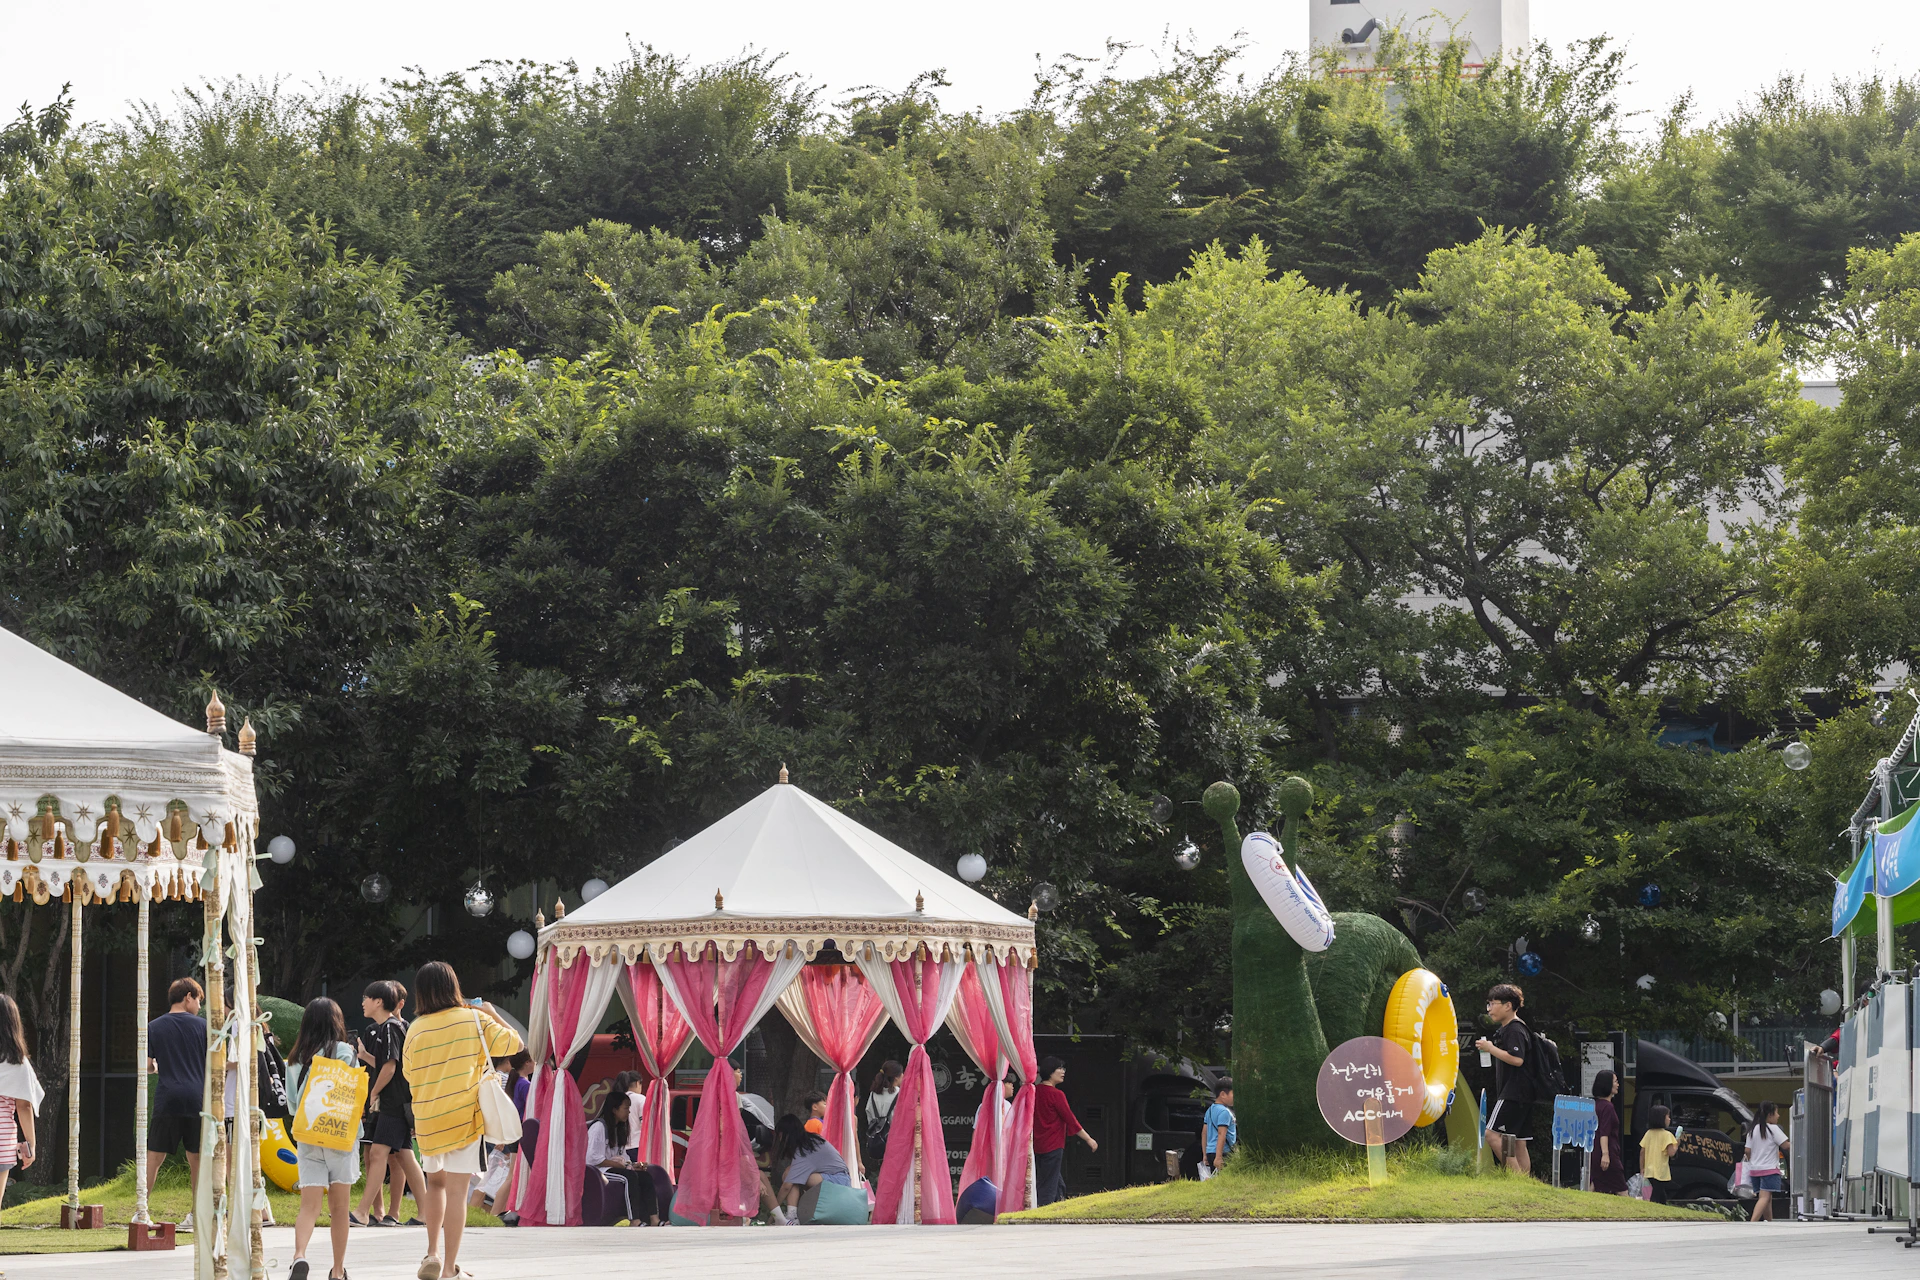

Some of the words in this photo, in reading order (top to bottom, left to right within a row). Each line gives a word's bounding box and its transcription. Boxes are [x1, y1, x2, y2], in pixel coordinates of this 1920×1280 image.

[317, 1064, 330, 1073] I'M
[332, 1067, 359, 1082] LITTLE
[1329, 1062, 1382, 1081] 천천히
[334, 1088, 356, 1100] CLEAN
[338, 1083, 356, 1095] LOVE
[1356, 1080, 1414, 1104] 여유롭게
[318, 1116, 348, 1132] SAVE
[942, 1116, 974, 1125] GGAKM
[1343, 1110, 1403, 1122] ACC에서
[312, 1126, 329, 1135] OUR
[330, 1128, 348, 1138] LIFE!
[1695, 1134, 1733, 1154] EVERYONE
[1680, 1144, 1698, 1155] JUST
[1702, 1148, 1716, 1160] FOR
[1719, 1151, 1734, 1164] YOU
